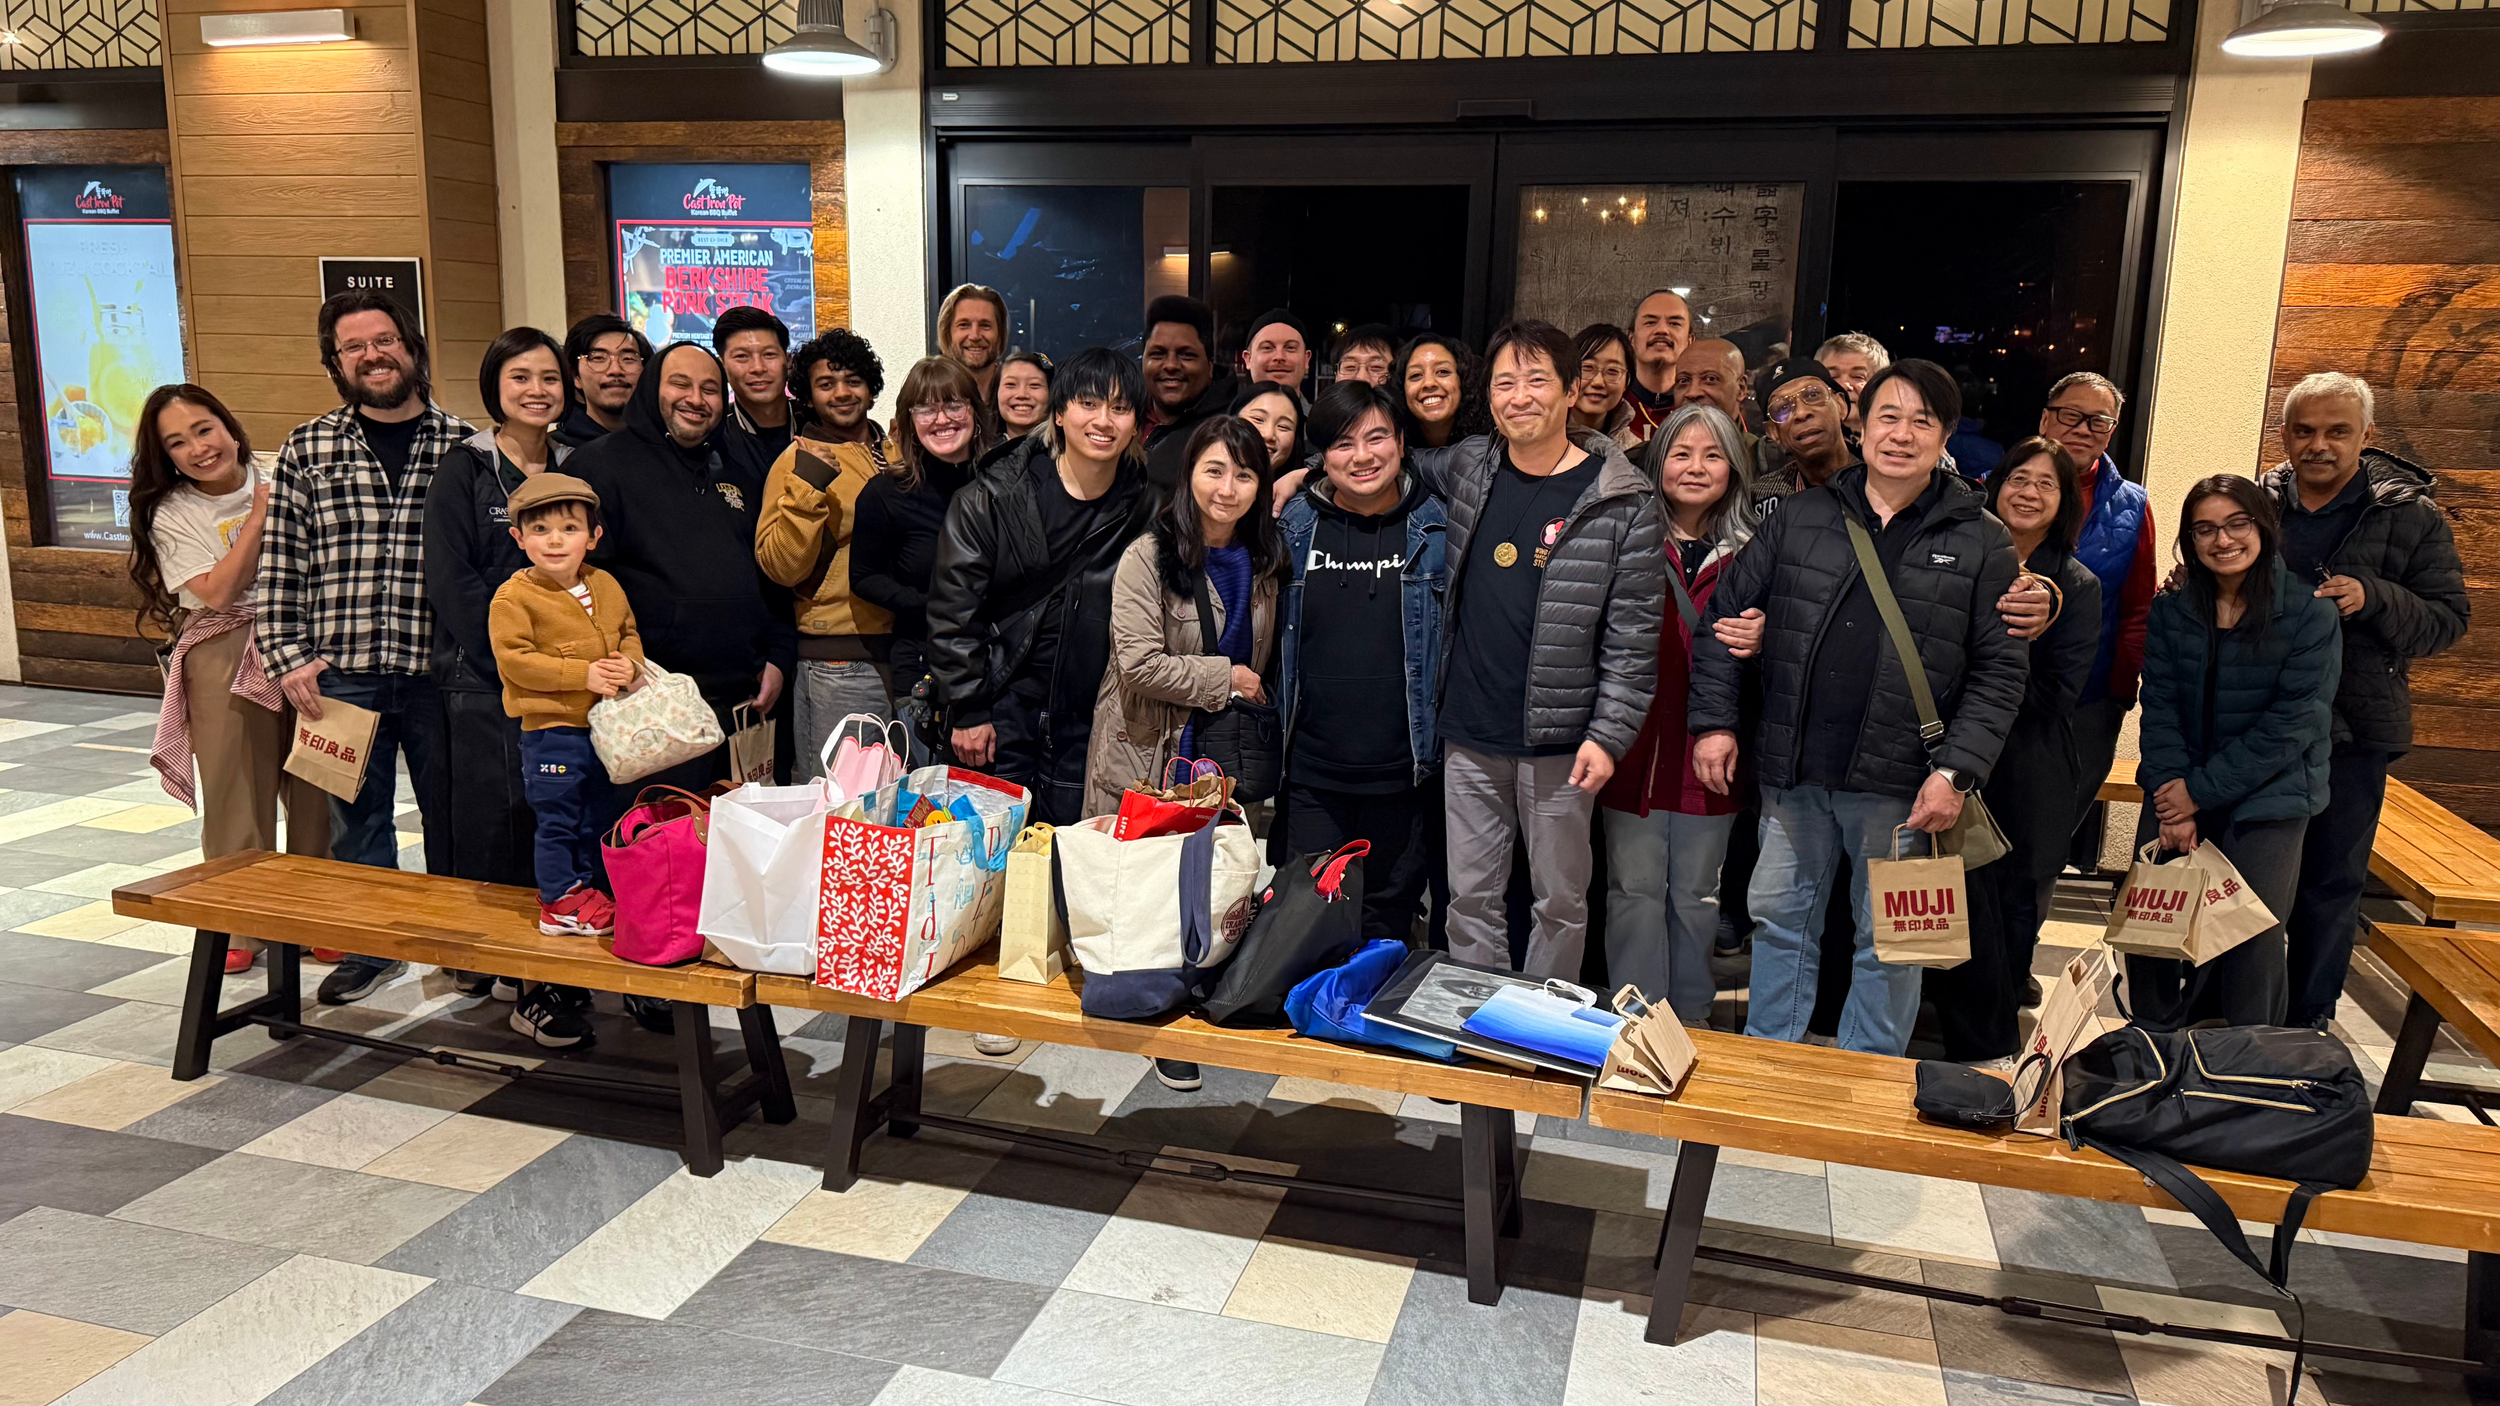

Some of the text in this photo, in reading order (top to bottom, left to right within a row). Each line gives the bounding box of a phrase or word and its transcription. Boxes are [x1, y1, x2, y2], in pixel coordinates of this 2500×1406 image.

[76, 194, 125, 209] Cast Iron Pot
[683, 193, 746, 210] Cast Iron Pot
[709, 209, 721, 217] BBQ
[660, 248, 774, 267] PREMIER AMERICAN
[347, 276, 394, 288] SUITE
[665, 266, 770, 292] BERKSHIRE
[662, 290, 711, 315] PORK
[298, 727, 356, 764] 無印良品
[2124, 886, 2188, 912] MUJI
[2204, 877, 2242, 908] 良品
[1884, 888, 1955, 918] MUJI
[1893, 918, 1949, 932] 無印良品
[2126, 909, 2173, 924] 無印良品
